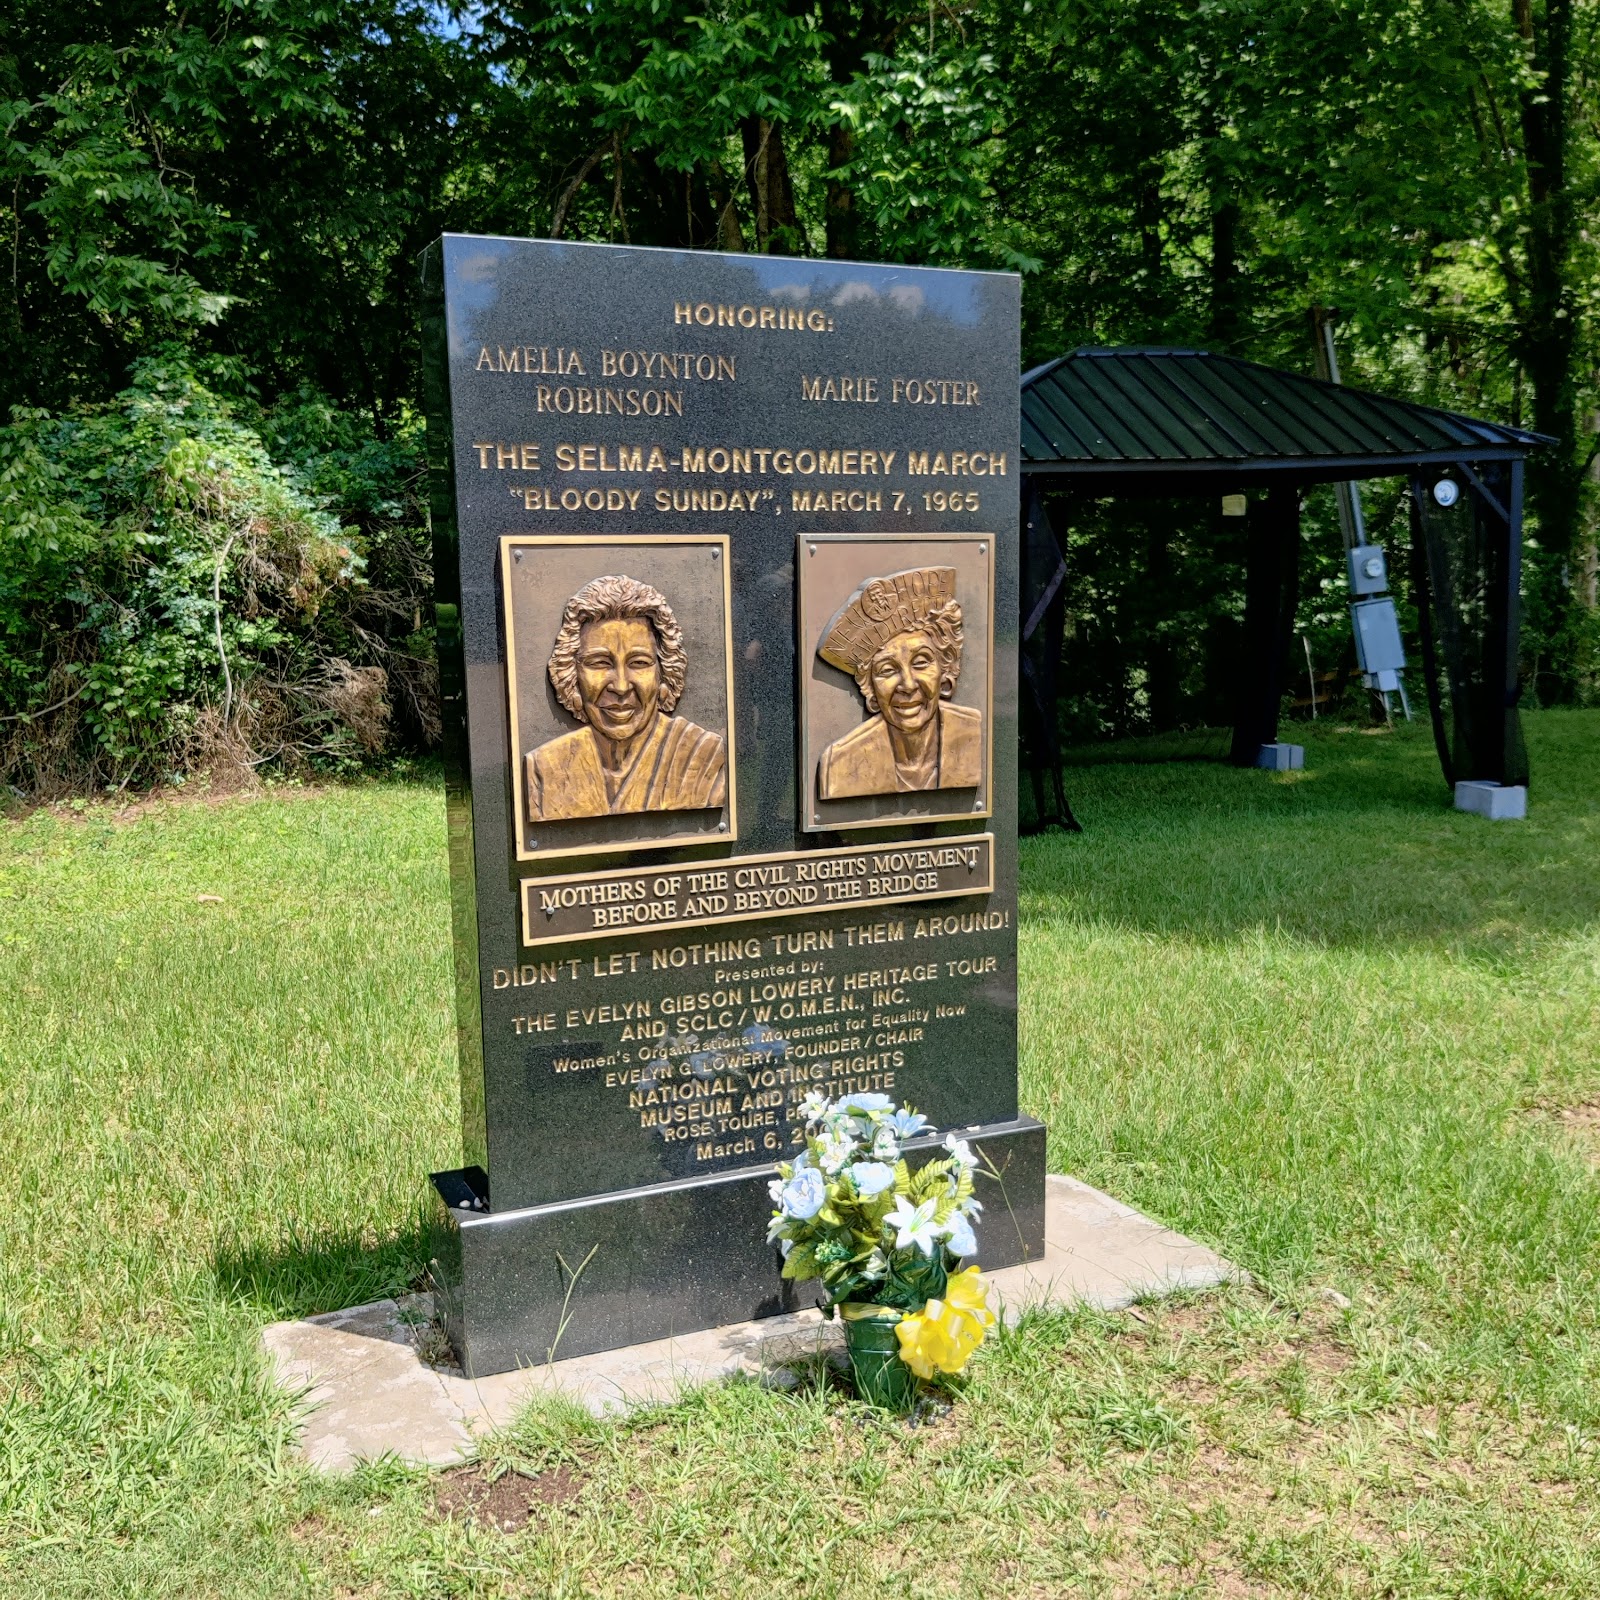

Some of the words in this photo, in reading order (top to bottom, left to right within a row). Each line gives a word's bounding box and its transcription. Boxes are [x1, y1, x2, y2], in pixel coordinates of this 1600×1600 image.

[674, 302, 834, 332] HONORING:
[475, 346, 586, 375] AMELIA
[601, 350, 737, 381] BOYNTON
[536, 384, 684, 417] ROBINSON
[801, 374, 879, 403] MARIE
[892, 378, 981, 405] FOSTER
[473, 441, 541, 470] THE
[556, 443, 896, 475] SELMA-MONTGOMERY
[908, 450, 1007, 476] MARCH
[791, 489, 882, 512] MARCH
[892, 491, 912, 515] 7,
[923, 490, 981, 512] 1965
[539, 881, 646, 910] MOTHERS
[653, 877, 681, 897] OF
[687, 872, 728, 892] THE
[735, 865, 790, 888] CIVIL
[795, 857, 867, 882] RIGHTS
[872, 847, 980, 874] MOVEMENT
[593, 901, 677, 928] BEFORE
[682, 896, 728, 917] AND
[734, 886, 818, 910] BEYOND
[823, 881, 862, 901] THE
[867, 872, 938, 896] BRIDGE
[493, 958, 582, 990] DIDN'T
[594, 952, 641, 977] LET
[652, 938, 761, 971] NOTHING
[772, 929, 834, 955] TURN
[844, 922, 904, 946] THEM
[913, 910, 1010, 938] AROUND!
[715, 961, 795, 984] Presented
[801, 961, 824, 974] by:
[511, 1014, 556, 1034] THE
[566, 1000, 650, 1028] EVELYN
[660, 988, 742, 1014] GIBSON
[750, 976, 836, 1003] LOWERY
[844, 964, 938, 990] HERITAGE
[946, 956, 997, 977] TOUR
[620, 1020, 667, 1042] AND
[872, 988, 910, 1007] INC.
[638, 1035, 755, 1061] Organizational
[761, 1023, 839, 1043] Movement
[845, 1018, 866, 1031] for
[872, 1006, 930, 1028] Equality
[935, 1004, 967, 1018] Now
[606, 1065, 672, 1087] EVELYN
[703, 1051, 778, 1073] LOWERY,
[629, 1076, 738, 1108] NATIONAL
[747, 1064, 824, 1089] VOTING
[831, 1051, 904, 1077] RIGHTS
[641, 1098, 732, 1128] MUSEUM
[741, 1090, 783, 1112] AND
[664, 1122, 711, 1142] ROSE
[720, 1111, 779, 1132] TOURE,
[697, 1136, 755, 1161] March
[764, 1132, 782, 1150] 6,
